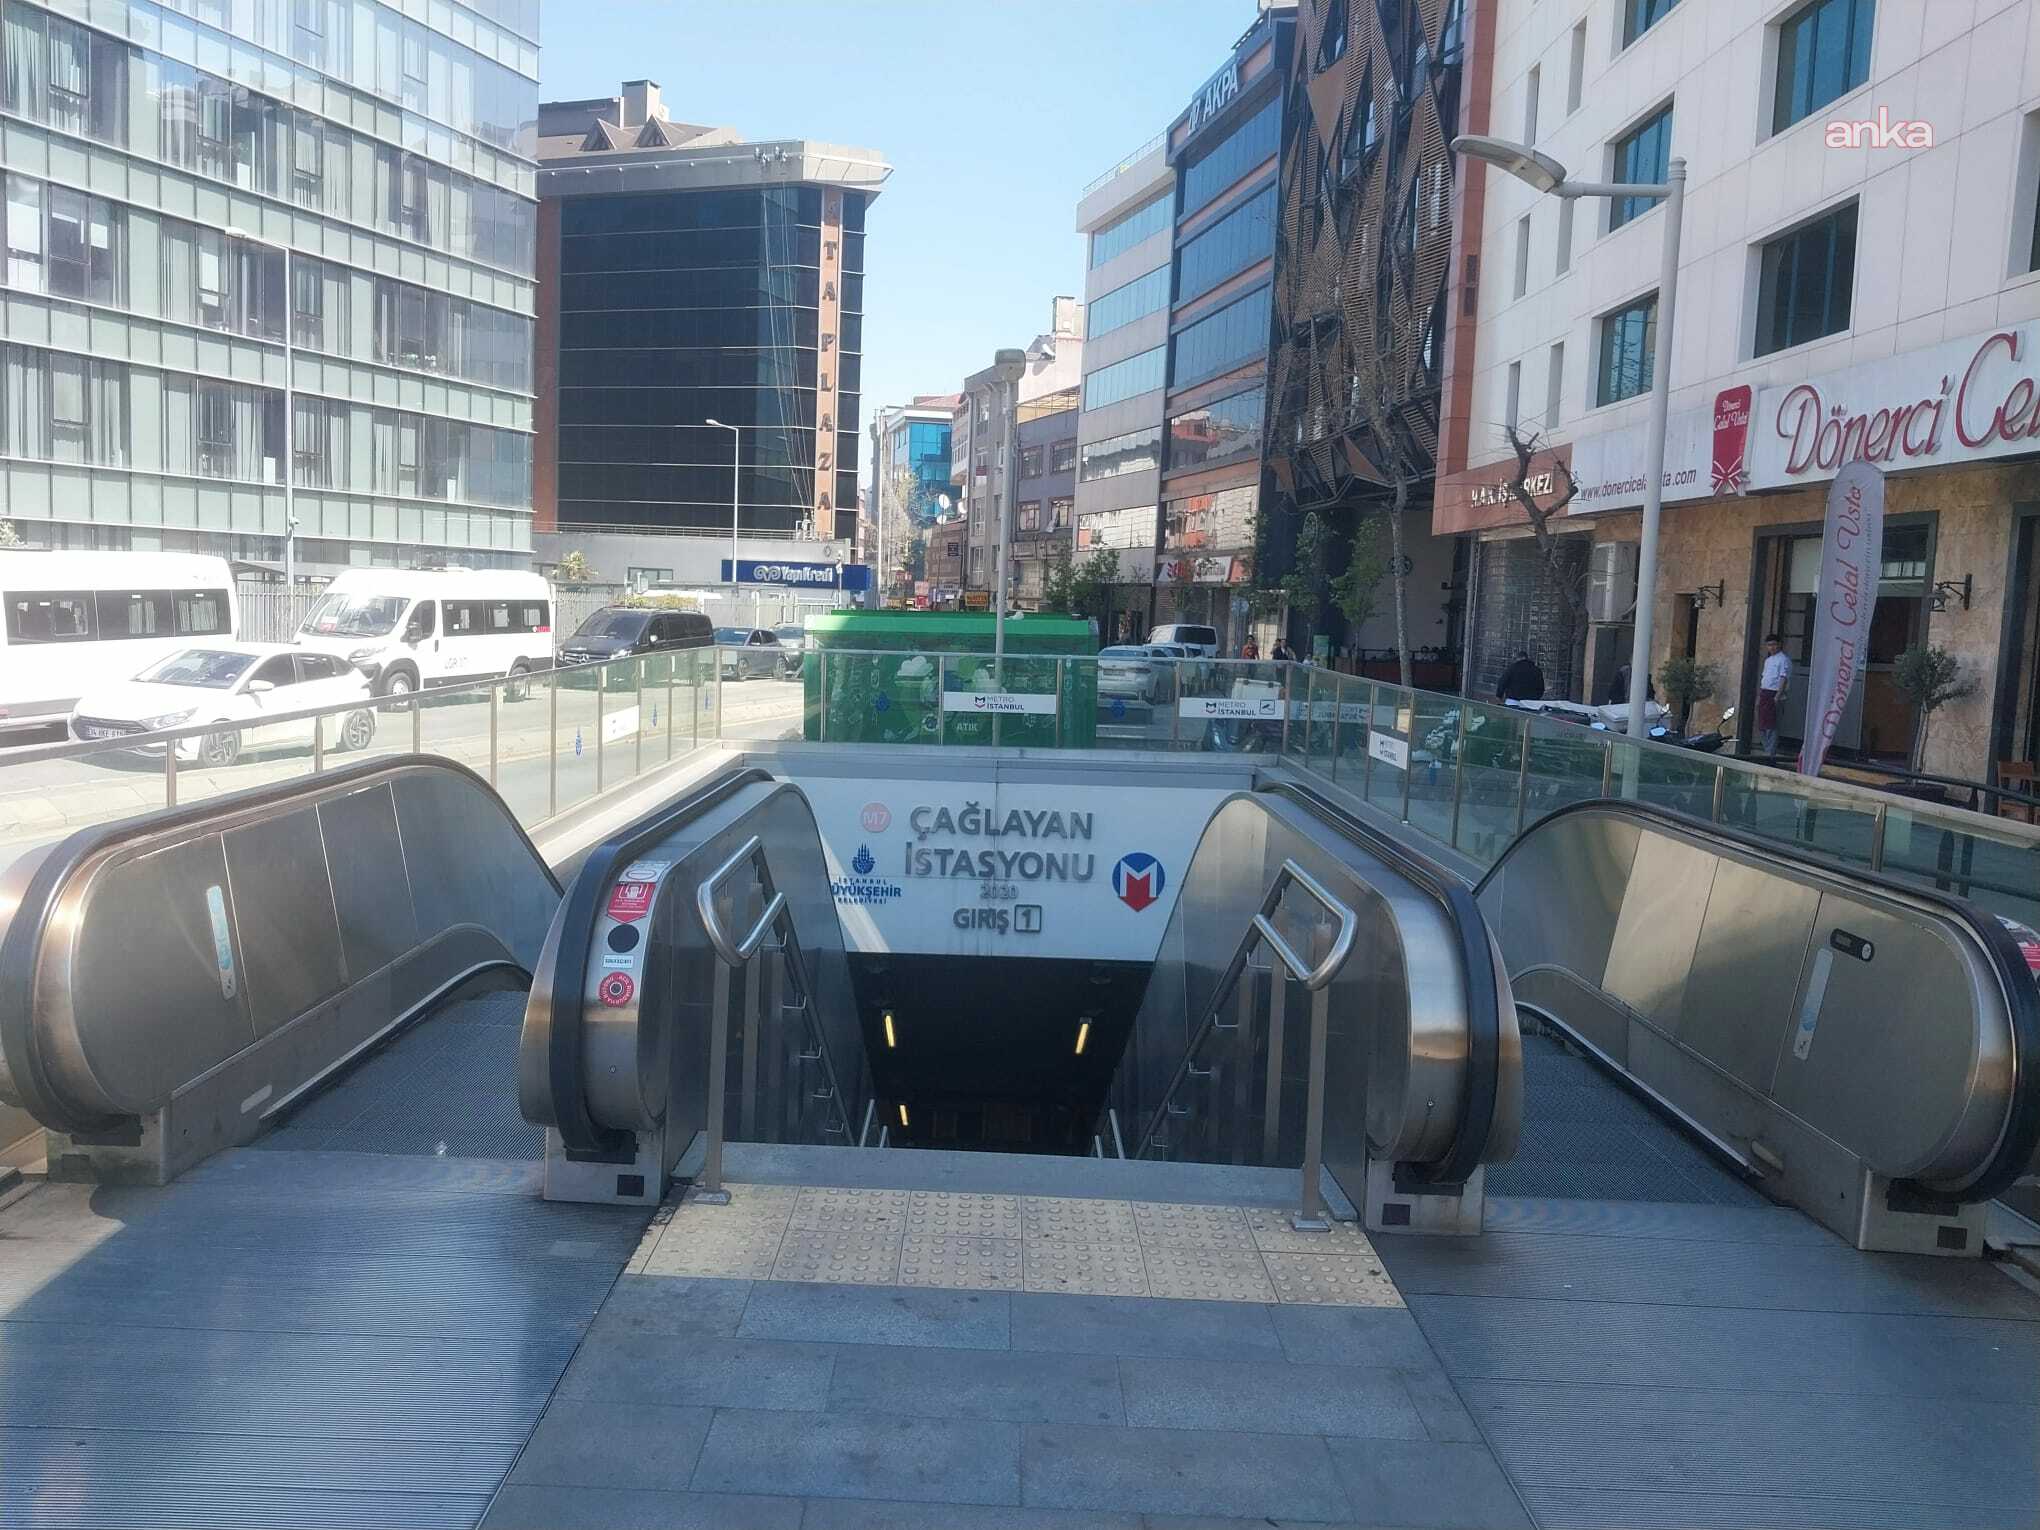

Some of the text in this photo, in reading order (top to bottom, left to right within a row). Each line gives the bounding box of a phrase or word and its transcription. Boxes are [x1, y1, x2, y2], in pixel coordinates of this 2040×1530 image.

[1203, 64, 1238, 122] AKPA
[1777, 375, 1953, 474] Dönerci
[1831, 559, 1859, 627] Celal
[863, 811, 888, 825] M7
[910, 801, 1094, 841] ÇAĞLAYAN
[905, 842, 1095, 882] İSTASYONU
[831, 882, 902, 898] ÜYÜKŞEHİR
